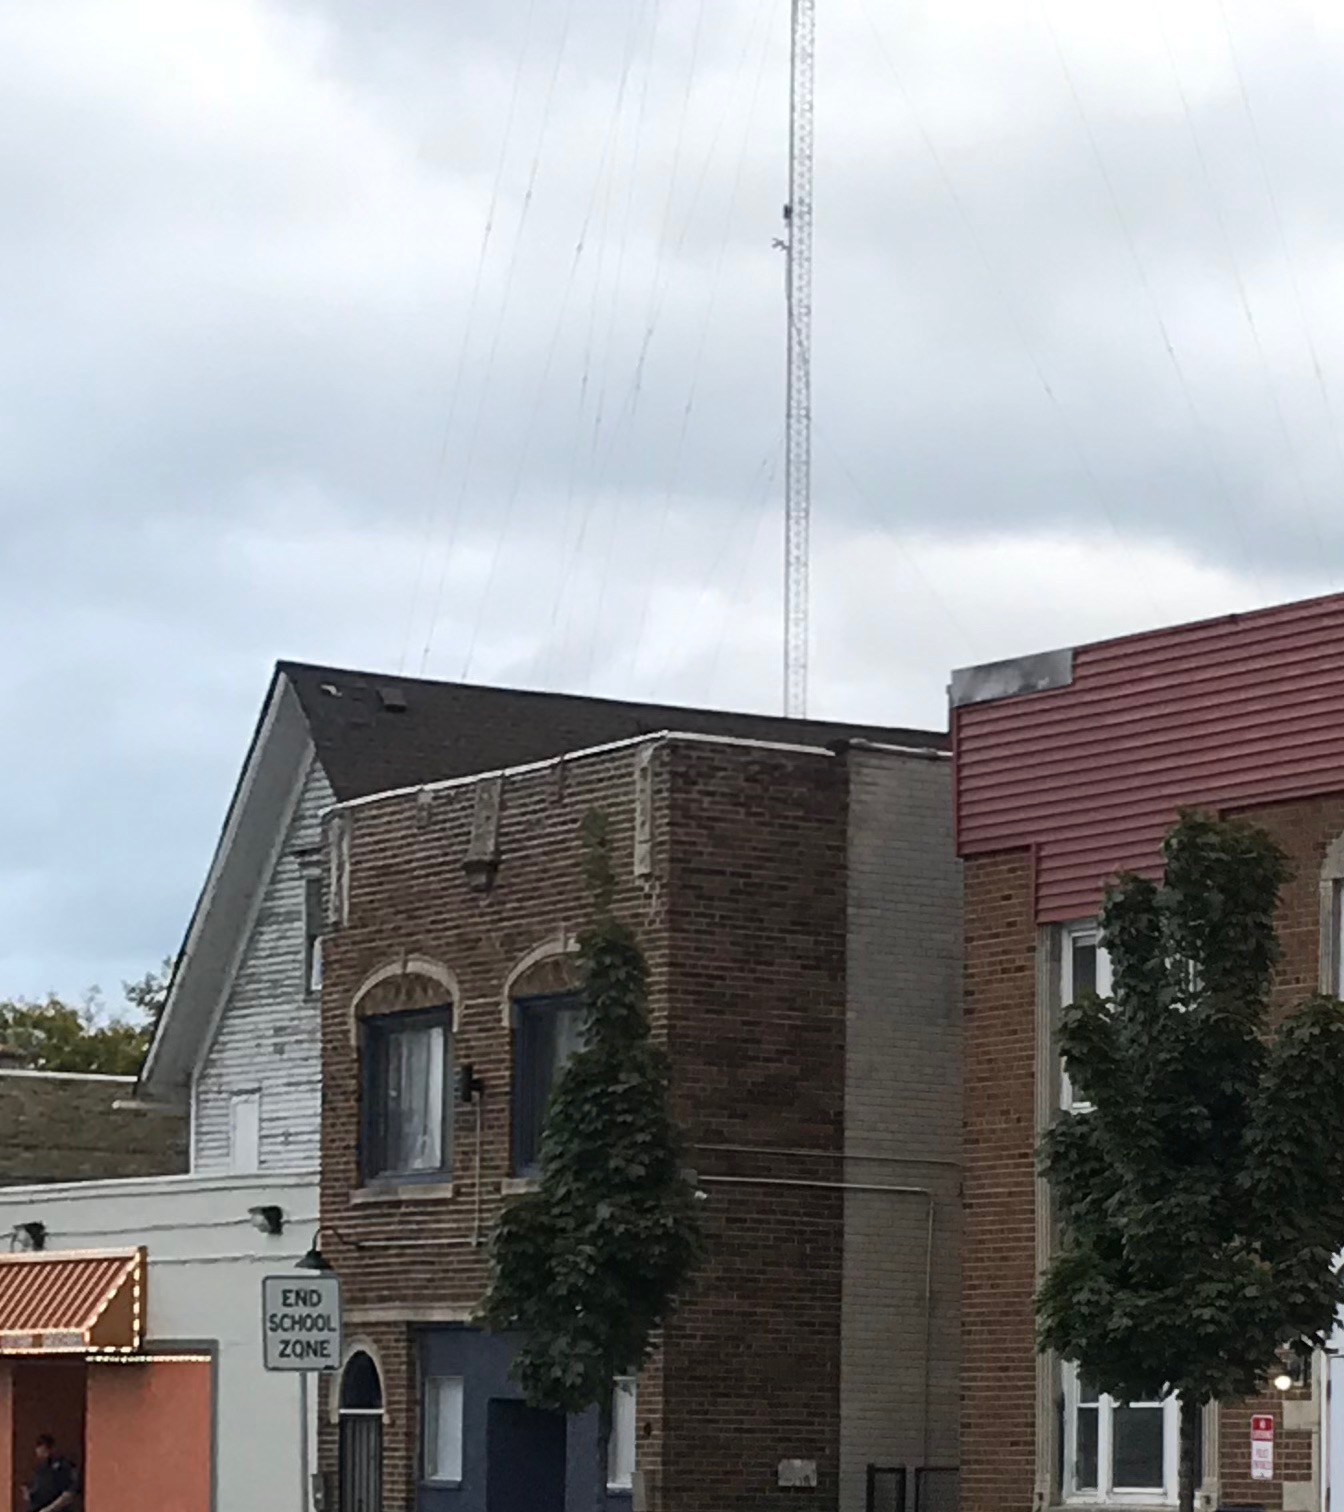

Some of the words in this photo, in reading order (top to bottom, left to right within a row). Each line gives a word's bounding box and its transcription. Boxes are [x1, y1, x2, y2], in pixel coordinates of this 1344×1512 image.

[282, 1289, 322, 1307] END
[268, 1313, 337, 1332] SCHOOL
[279, 1339, 331, 1358] ZONE
